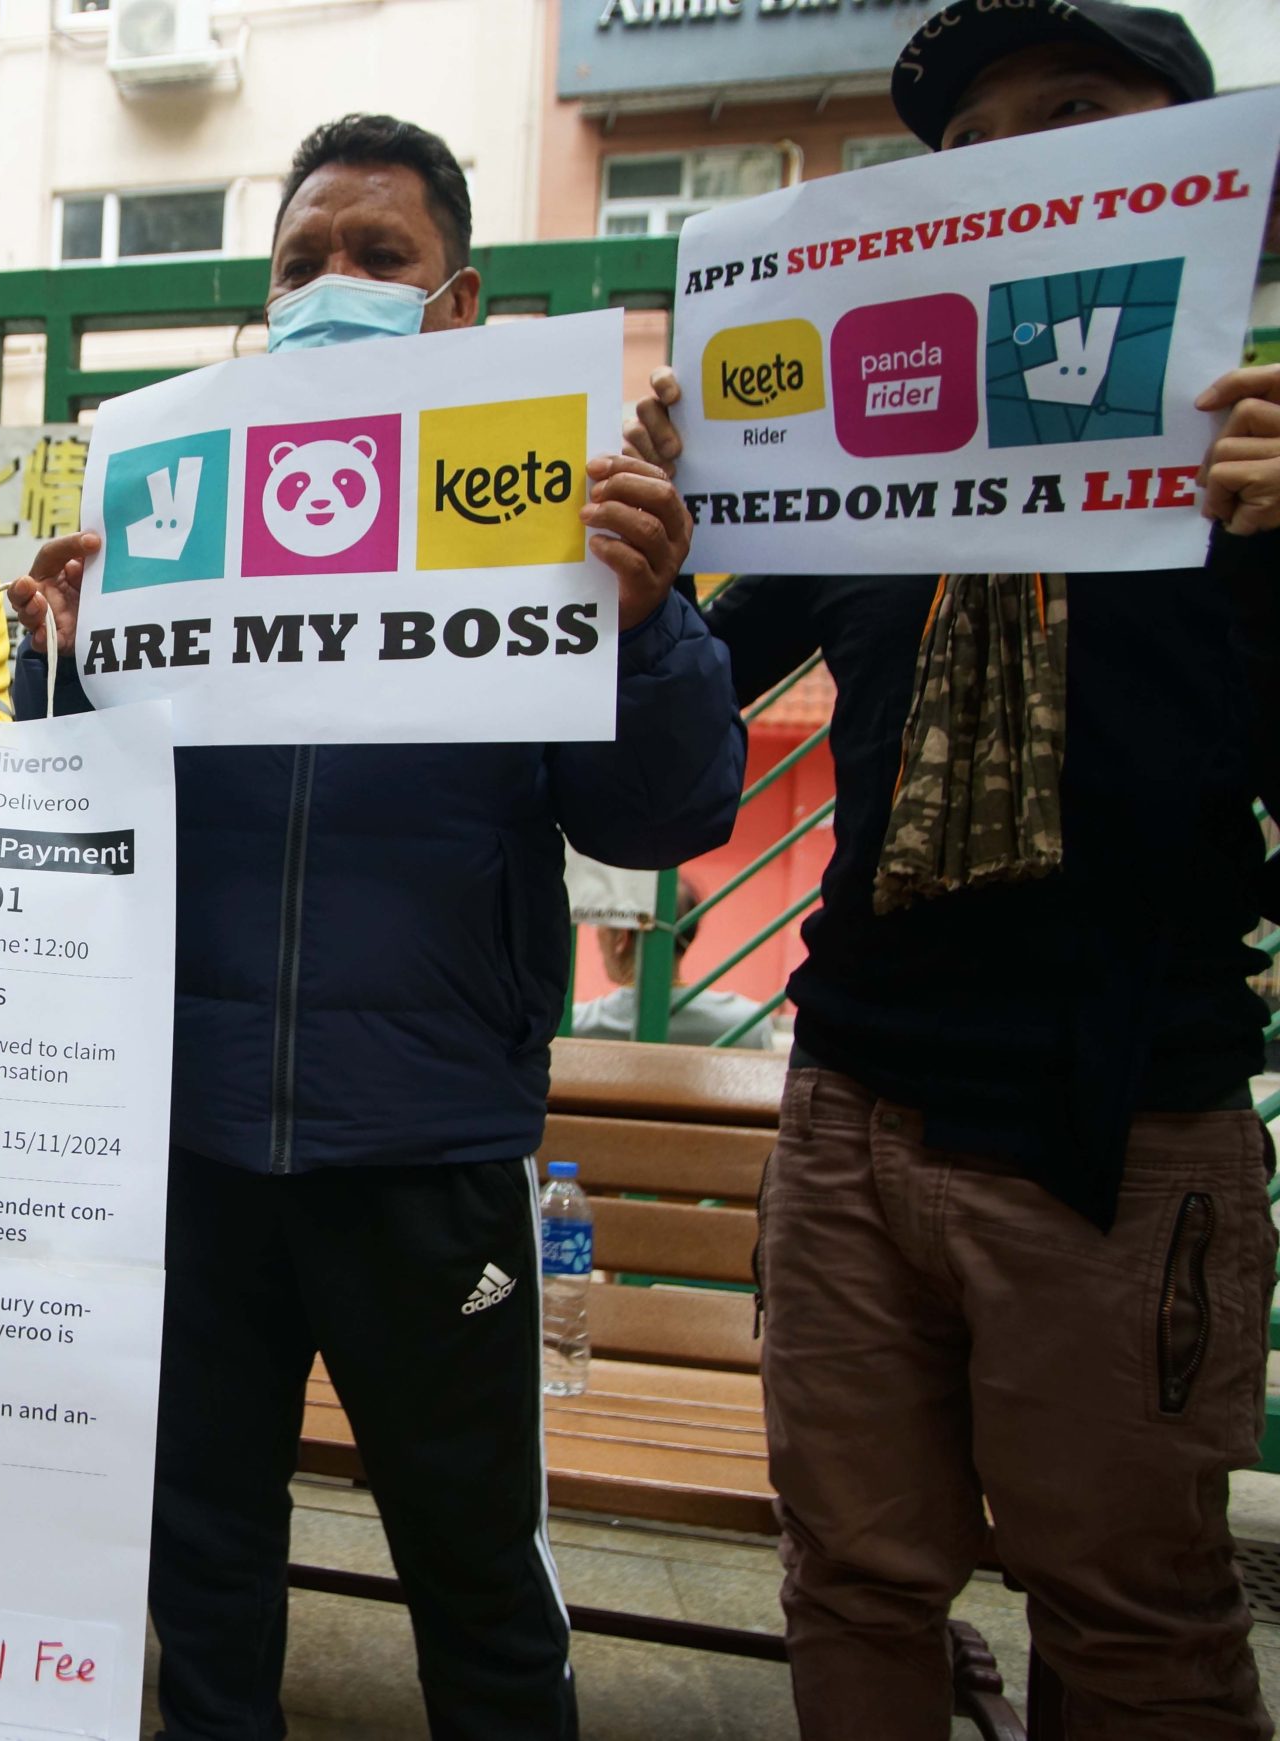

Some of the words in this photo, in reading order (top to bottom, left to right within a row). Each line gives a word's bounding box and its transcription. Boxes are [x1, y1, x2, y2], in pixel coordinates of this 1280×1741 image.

[685, 258, 744, 295] APP
[751, 252, 779, 282] IS
[787, 195, 1083, 275] SUPERVISION
[1093, 169, 1250, 221] TOOL
[861, 341, 942, 380] panda
[721, 353, 804, 406] keeta
[871, 383, 934, 410] rider
[743, 427, 787, 447] Rider
[435, 451, 572, 525] keeta
[681, 481, 938, 525] FREEDOM
[951, 478, 1007, 517] IS
[1022, 474, 1066, 514] A
[1081, 465, 1201, 511] LIE
[83, 618, 211, 675] ARE
[232, 613, 358, 664] MY
[378, 602, 599, 661] BOSS
[0, 837, 129, 867] Payment
[38, 1041, 58, 1058] to
[63, 1042, 116, 1061] claim
[2, 1130, 122, 1157] 15/11/2024
[70, 1203, 114, 1221] con-
[39, 1299, 92, 1317] com-
[58, 1325, 74, 1344] is
[19, 1402, 58, 1422] and
[64, 1409, 97, 1426] an-
[34, 1640, 96, 1683] Fee
